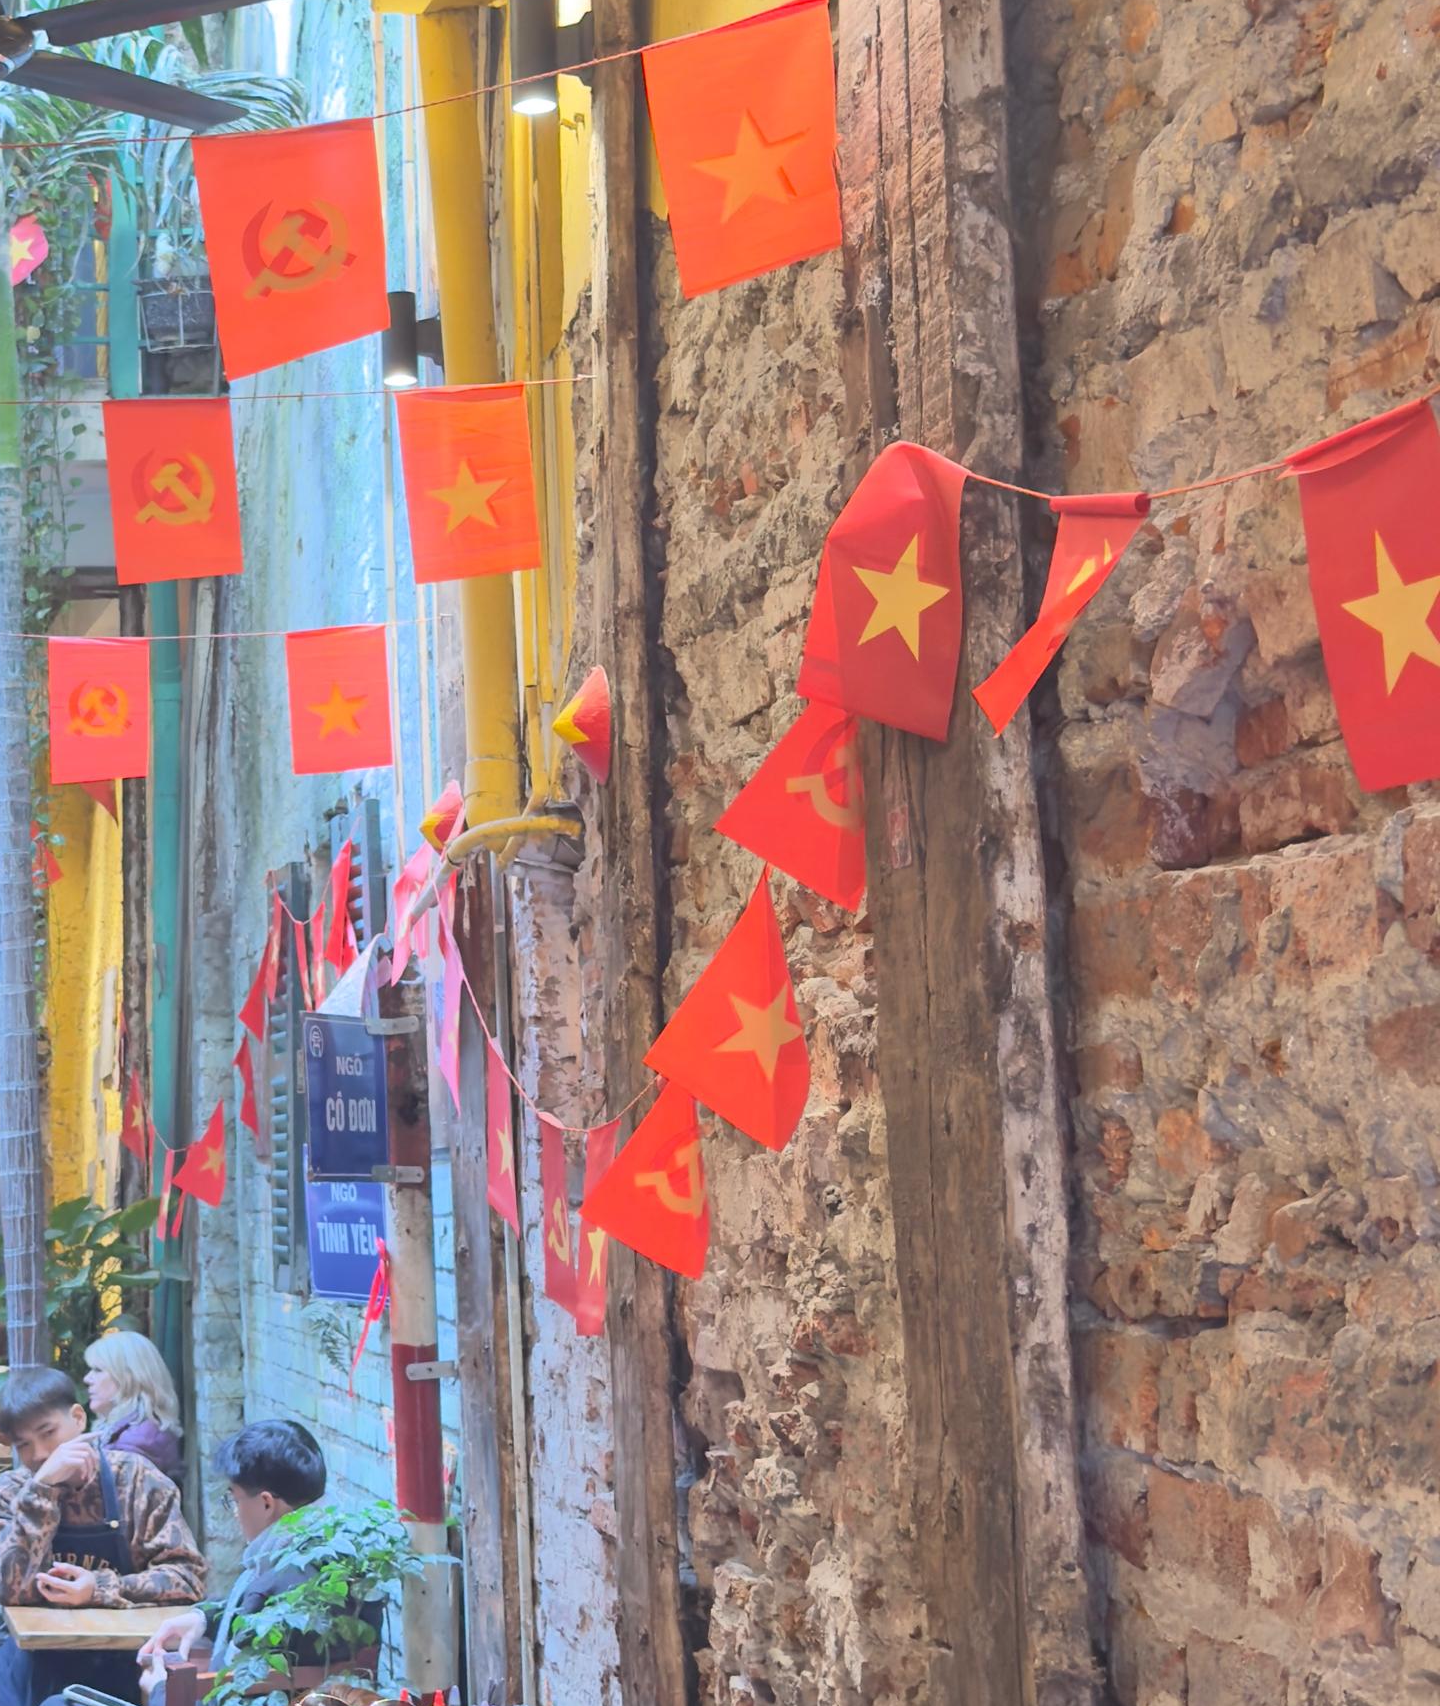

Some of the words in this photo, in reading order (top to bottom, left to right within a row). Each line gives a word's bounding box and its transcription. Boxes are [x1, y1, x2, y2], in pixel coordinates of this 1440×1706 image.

[326, 1091, 345, 1131] CÔ
[348, 1097, 377, 1132] ĐƠN
[317, 1215, 349, 1253] TÌNH
[350, 1216, 378, 1256] YÊU
